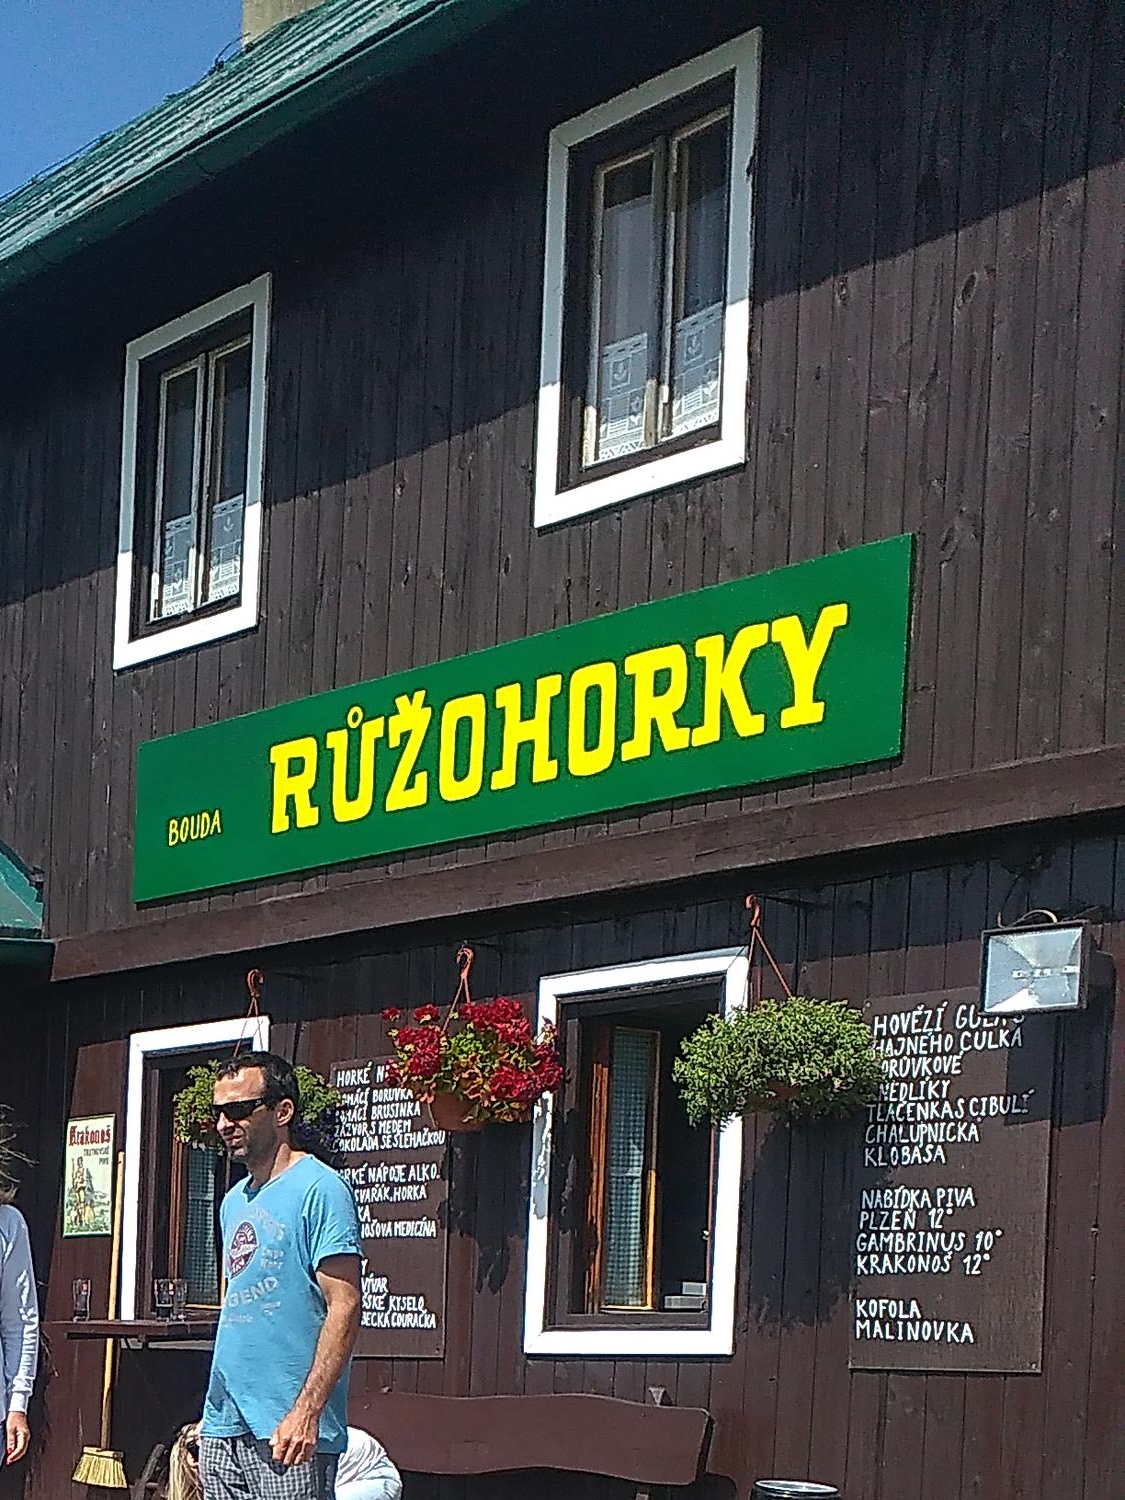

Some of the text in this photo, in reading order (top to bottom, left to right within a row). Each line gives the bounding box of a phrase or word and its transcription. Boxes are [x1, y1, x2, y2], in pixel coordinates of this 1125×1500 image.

[168, 602, 849, 847] BOUDA RŮŽOHORKY
[874, 1001, 949, 1036] HOVĚZÍ
[336, 1061, 372, 1088] HORKÉ
[69, 1125, 111, 1147] Krakonoš
[936, 1186, 976, 1208] PIVA
[856, 1231, 967, 1253] GAMBRINUS
[856, 1251, 954, 1275] KRAKONOŠ
[856, 1299, 922, 1319] KOFOLA
[855, 1319, 975, 1344] MALINOVKA
